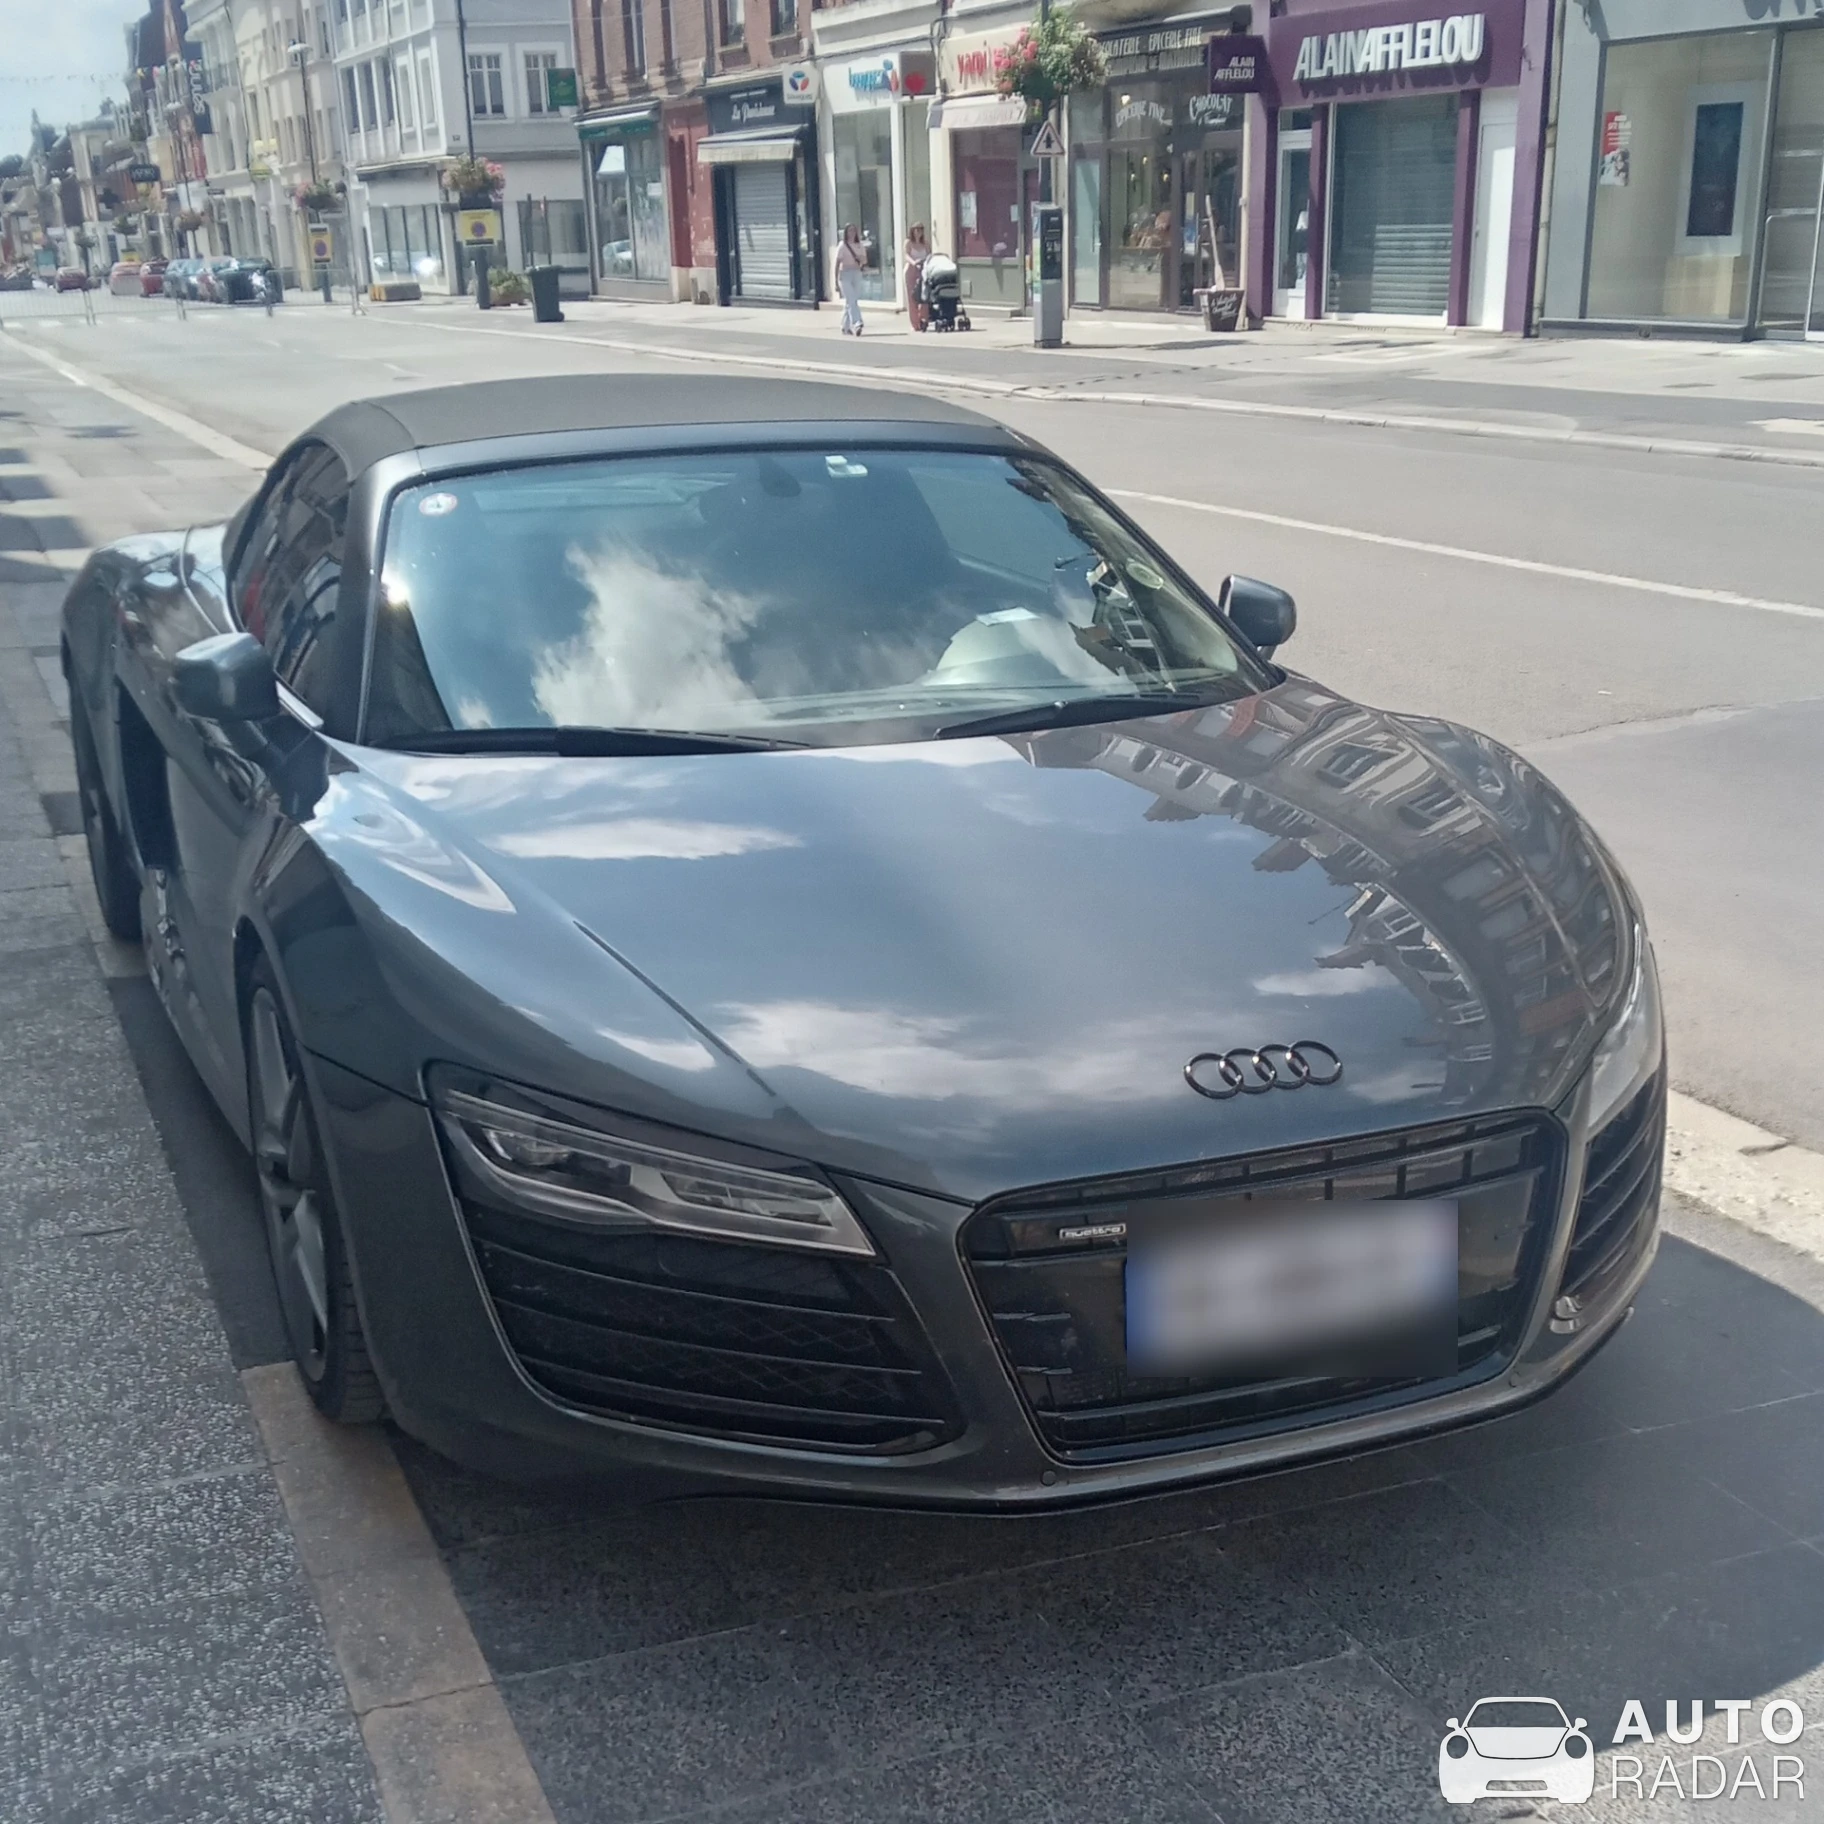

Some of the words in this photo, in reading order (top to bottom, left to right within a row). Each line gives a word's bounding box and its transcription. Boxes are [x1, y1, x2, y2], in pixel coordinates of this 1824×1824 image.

[1293, 29, 1367, 80] ALAIN
[1355, 13, 1485, 73] AFFLELOU
[1229, 56, 1255, 67] ALAIN
[1214, 68, 1255, 80] AFFLELOU
[1064, 1225, 1121, 1239] quattro
